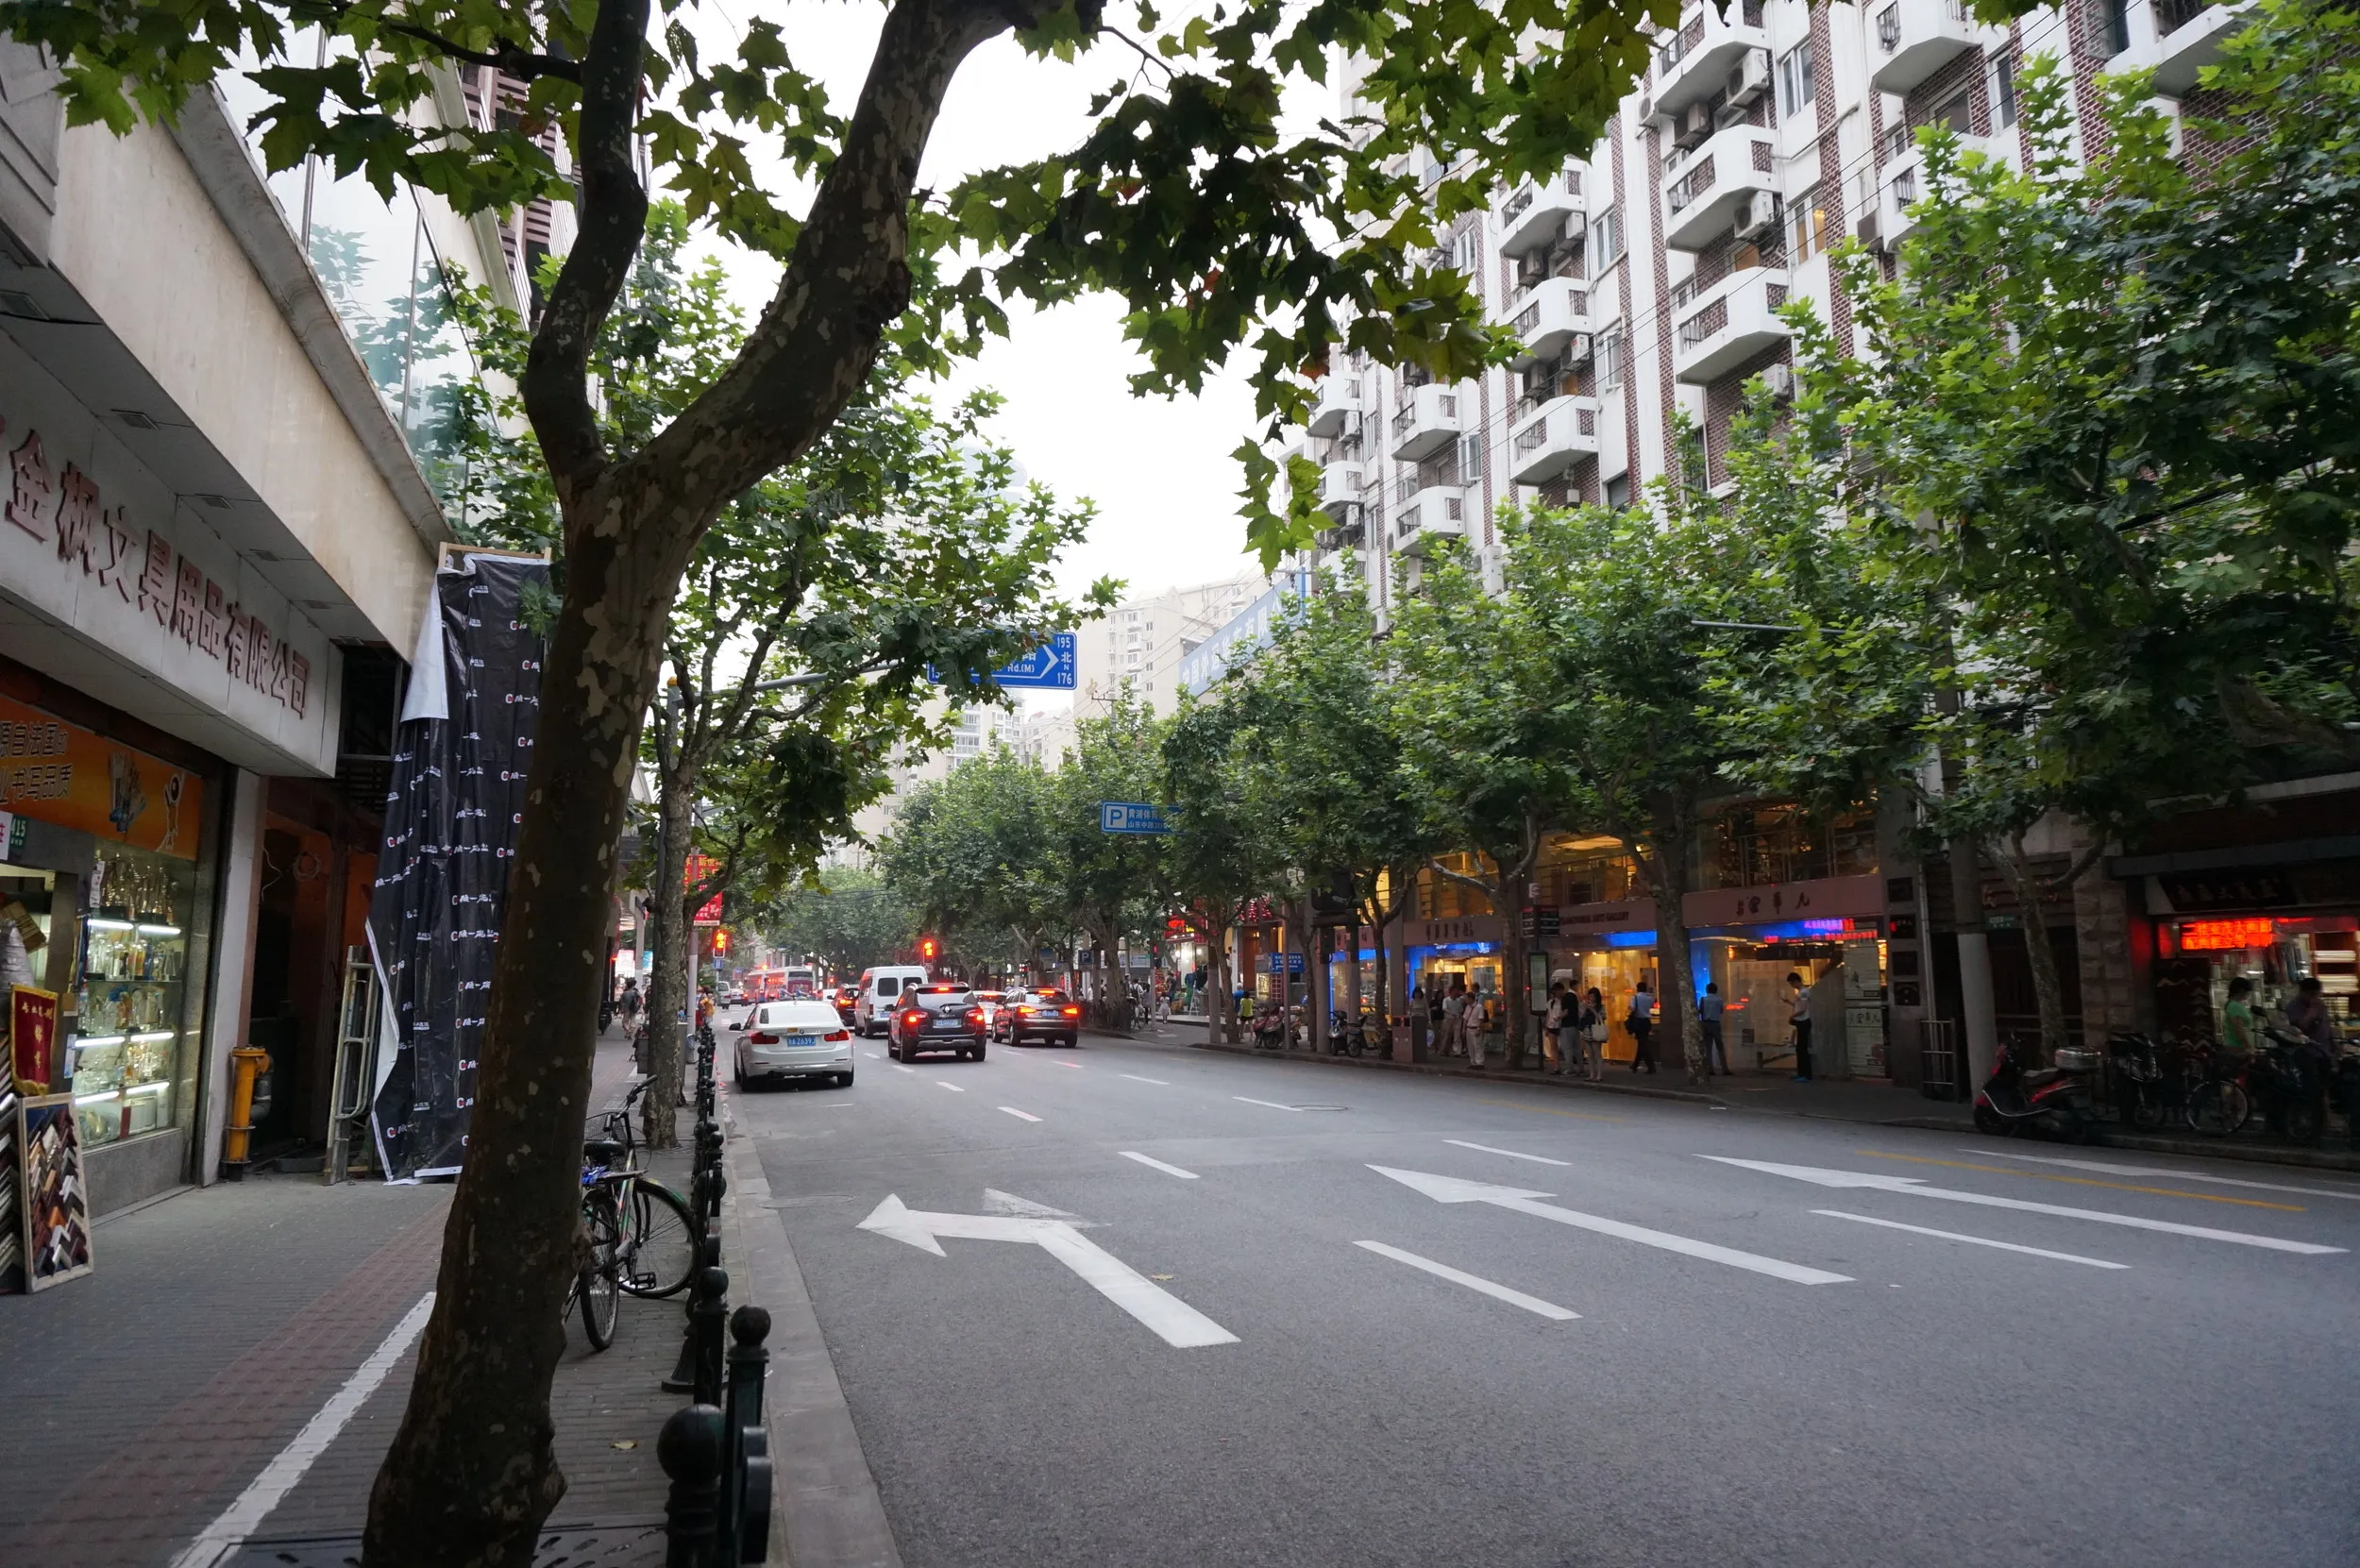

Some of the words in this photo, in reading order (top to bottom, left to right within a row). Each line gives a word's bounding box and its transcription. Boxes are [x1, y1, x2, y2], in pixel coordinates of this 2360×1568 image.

[1056, 636, 1071, 649] 195
[1060, 651, 1072, 664] 北
[1056, 672, 1072, 684] 176
